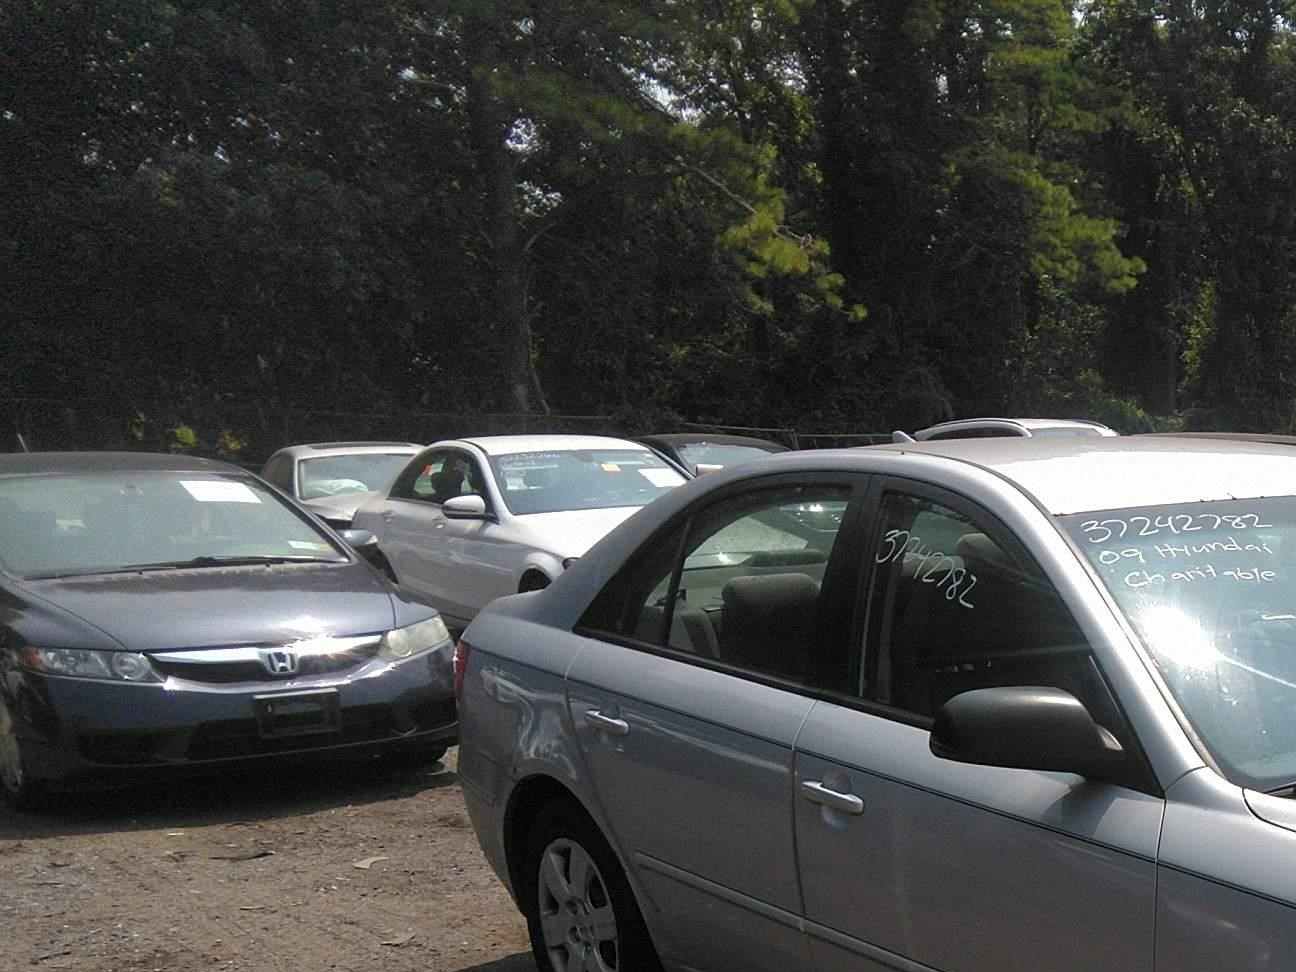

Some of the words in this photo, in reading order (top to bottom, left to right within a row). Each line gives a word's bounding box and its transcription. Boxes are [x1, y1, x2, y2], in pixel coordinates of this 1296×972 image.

[1080, 514, 1273, 543] 37242782
[875, 529, 978, 609] 37242782
[1099, 549, 1147, 565] 09
